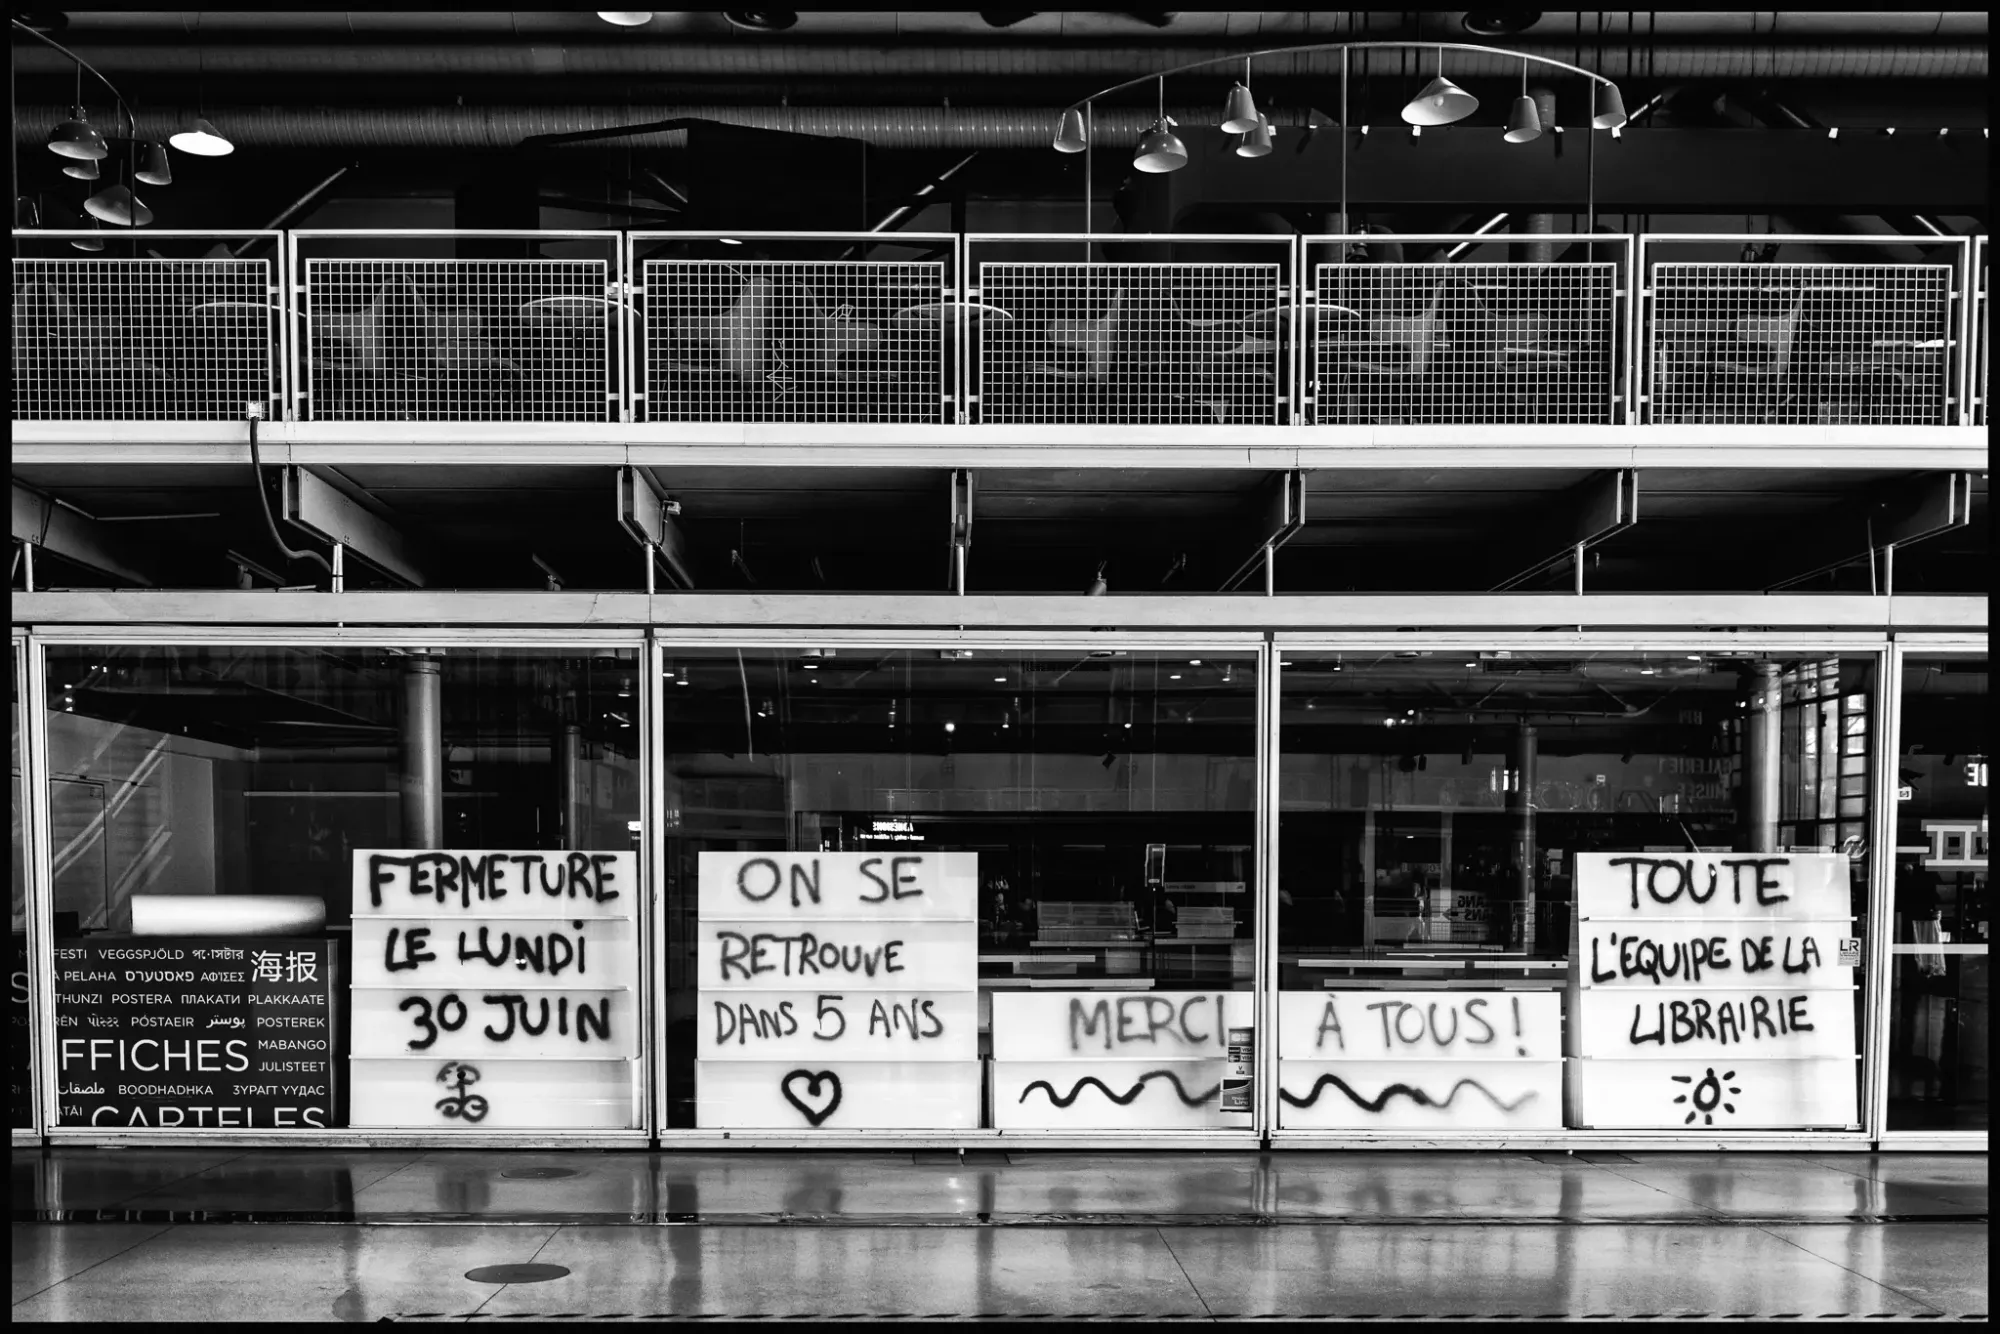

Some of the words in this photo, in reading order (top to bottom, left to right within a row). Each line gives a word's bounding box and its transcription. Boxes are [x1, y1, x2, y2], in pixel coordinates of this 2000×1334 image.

[369, 852, 620, 908] FERMETURE
[737, 857, 821, 908] ON
[859, 856, 924, 903] SE
[1608, 857, 1790, 909] TOUTE
[98, 947, 185, 960] VEGGSPJÖLD
[250, 949, 319, 982] 海报
[385, 926, 436, 972] LE
[716, 931, 905, 981] RETROUVE
[1740, 935, 1775, 974] DE
[1782, 935, 1822, 974] LA
[111, 993, 173, 1004] POSTERA
[181, 994, 241, 1005] ПЛАКАТИ
[247, 994, 325, 1005] PLAKKAATE
[131, 1014, 195, 1027] PÓSTAEIR
[257, 1016, 325, 1028] POSTEREK
[399, 993, 468, 1050] 30
[482, 994, 611, 1042] JUIN
[714, 1000, 798, 1045] DANS
[813, 994, 846, 1041] 5
[868, 998, 944, 1040] ANS
[1069, 994, 1226, 1050] MERCI
[1316, 993, 1344, 1048] À
[1629, 995, 1815, 1046] LIBRAIRIE
[61, 1038, 250, 1072] FFICHES
[258, 1039, 327, 1051] MABANGO
[258, 1061, 326, 1072] JULISTEET
[118, 1084, 214, 1095] BOODHADHKA
